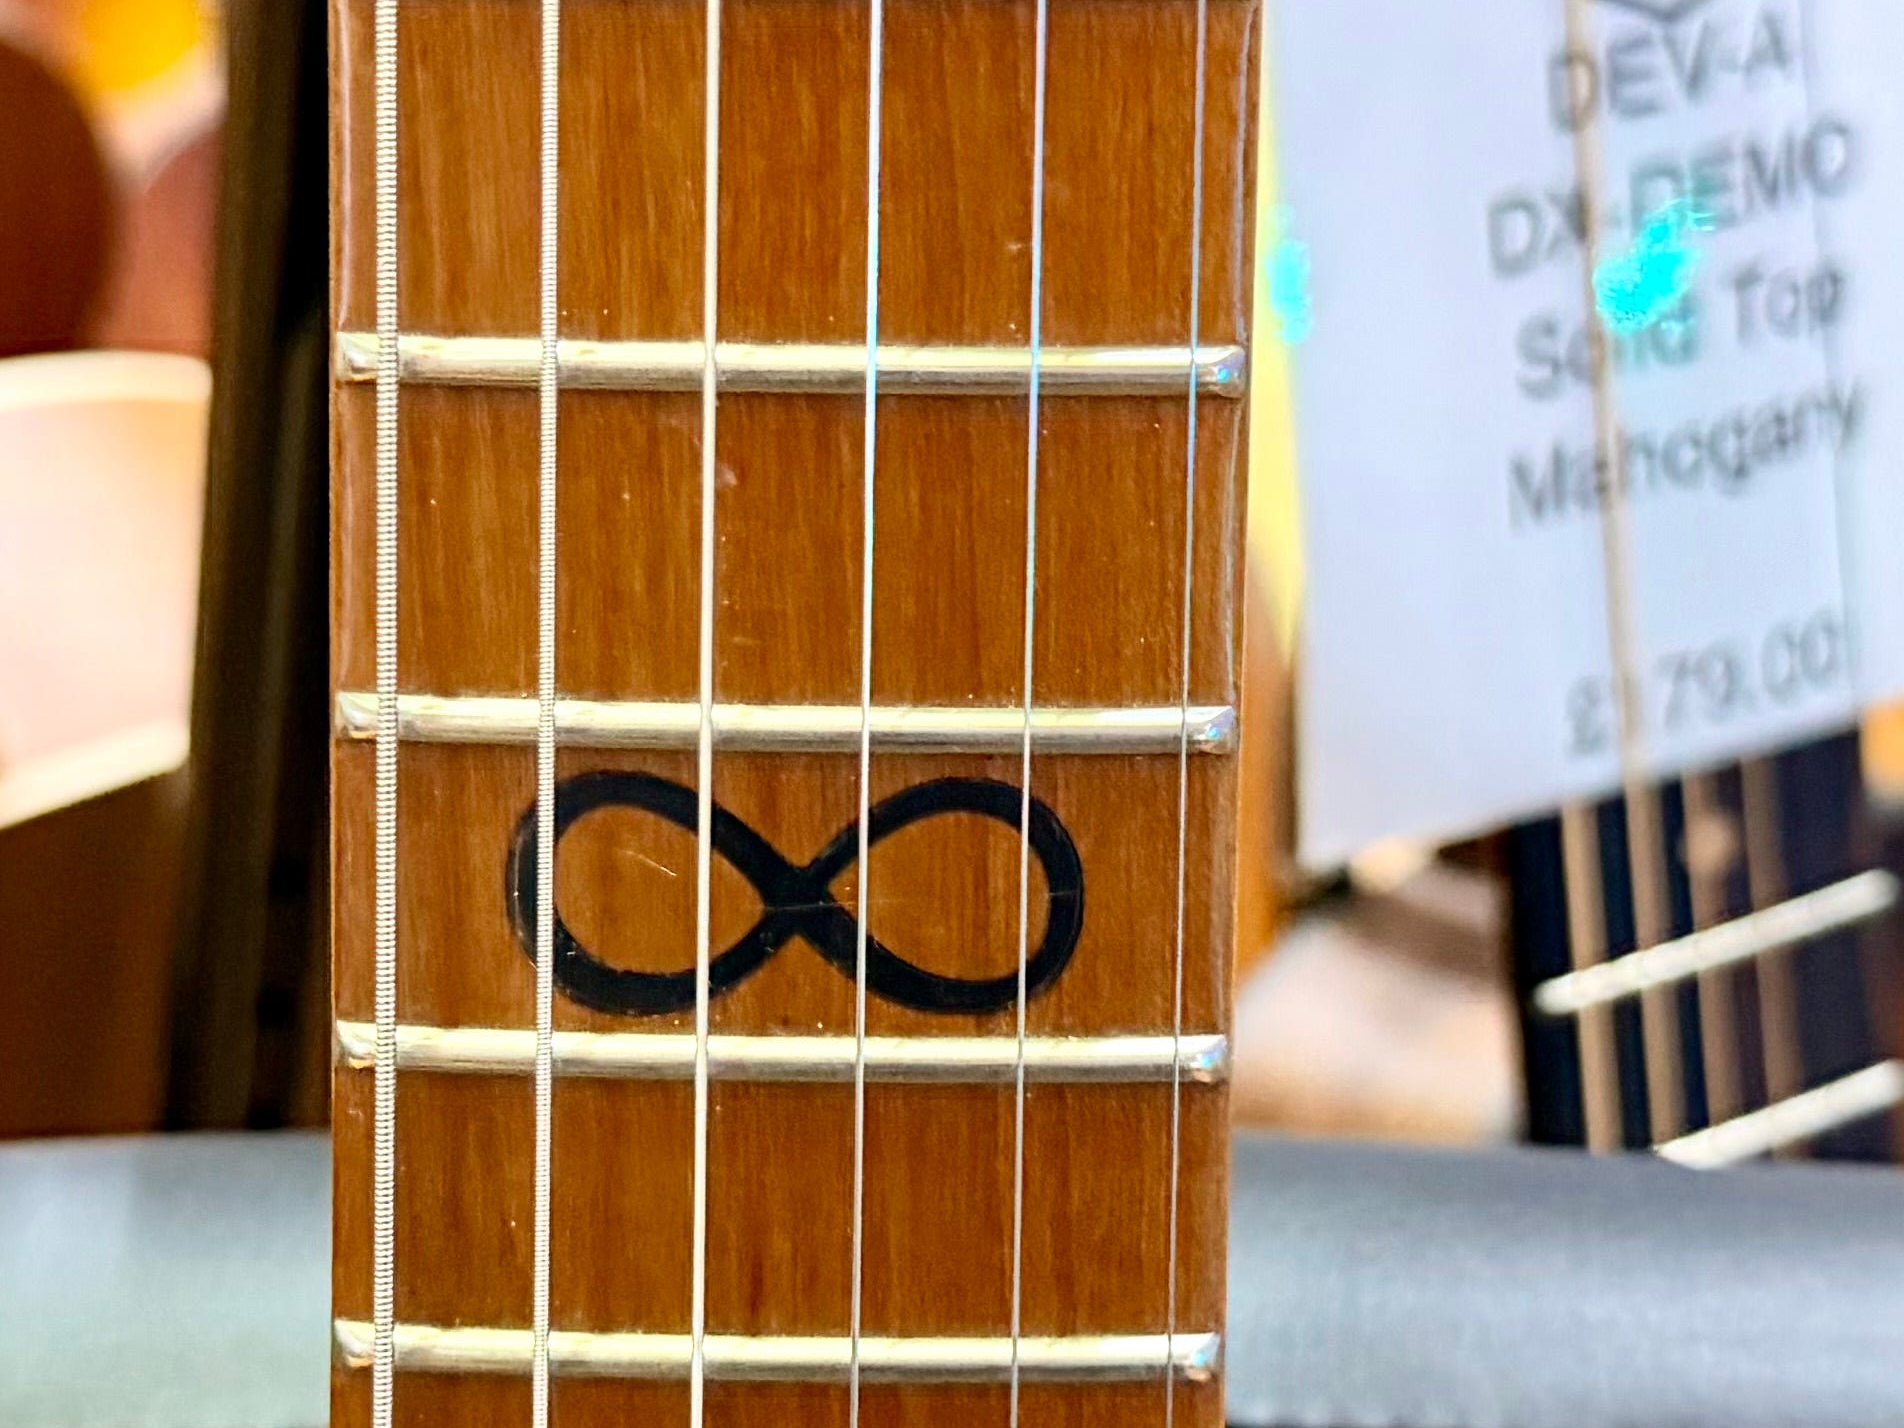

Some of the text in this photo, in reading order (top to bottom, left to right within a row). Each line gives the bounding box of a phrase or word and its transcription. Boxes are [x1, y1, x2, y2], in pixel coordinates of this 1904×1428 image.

[1546, 8, 1792, 134] DEV-A
[1726, 260, 1846, 350] Top
[1508, 380, 1864, 528] Mahogany
